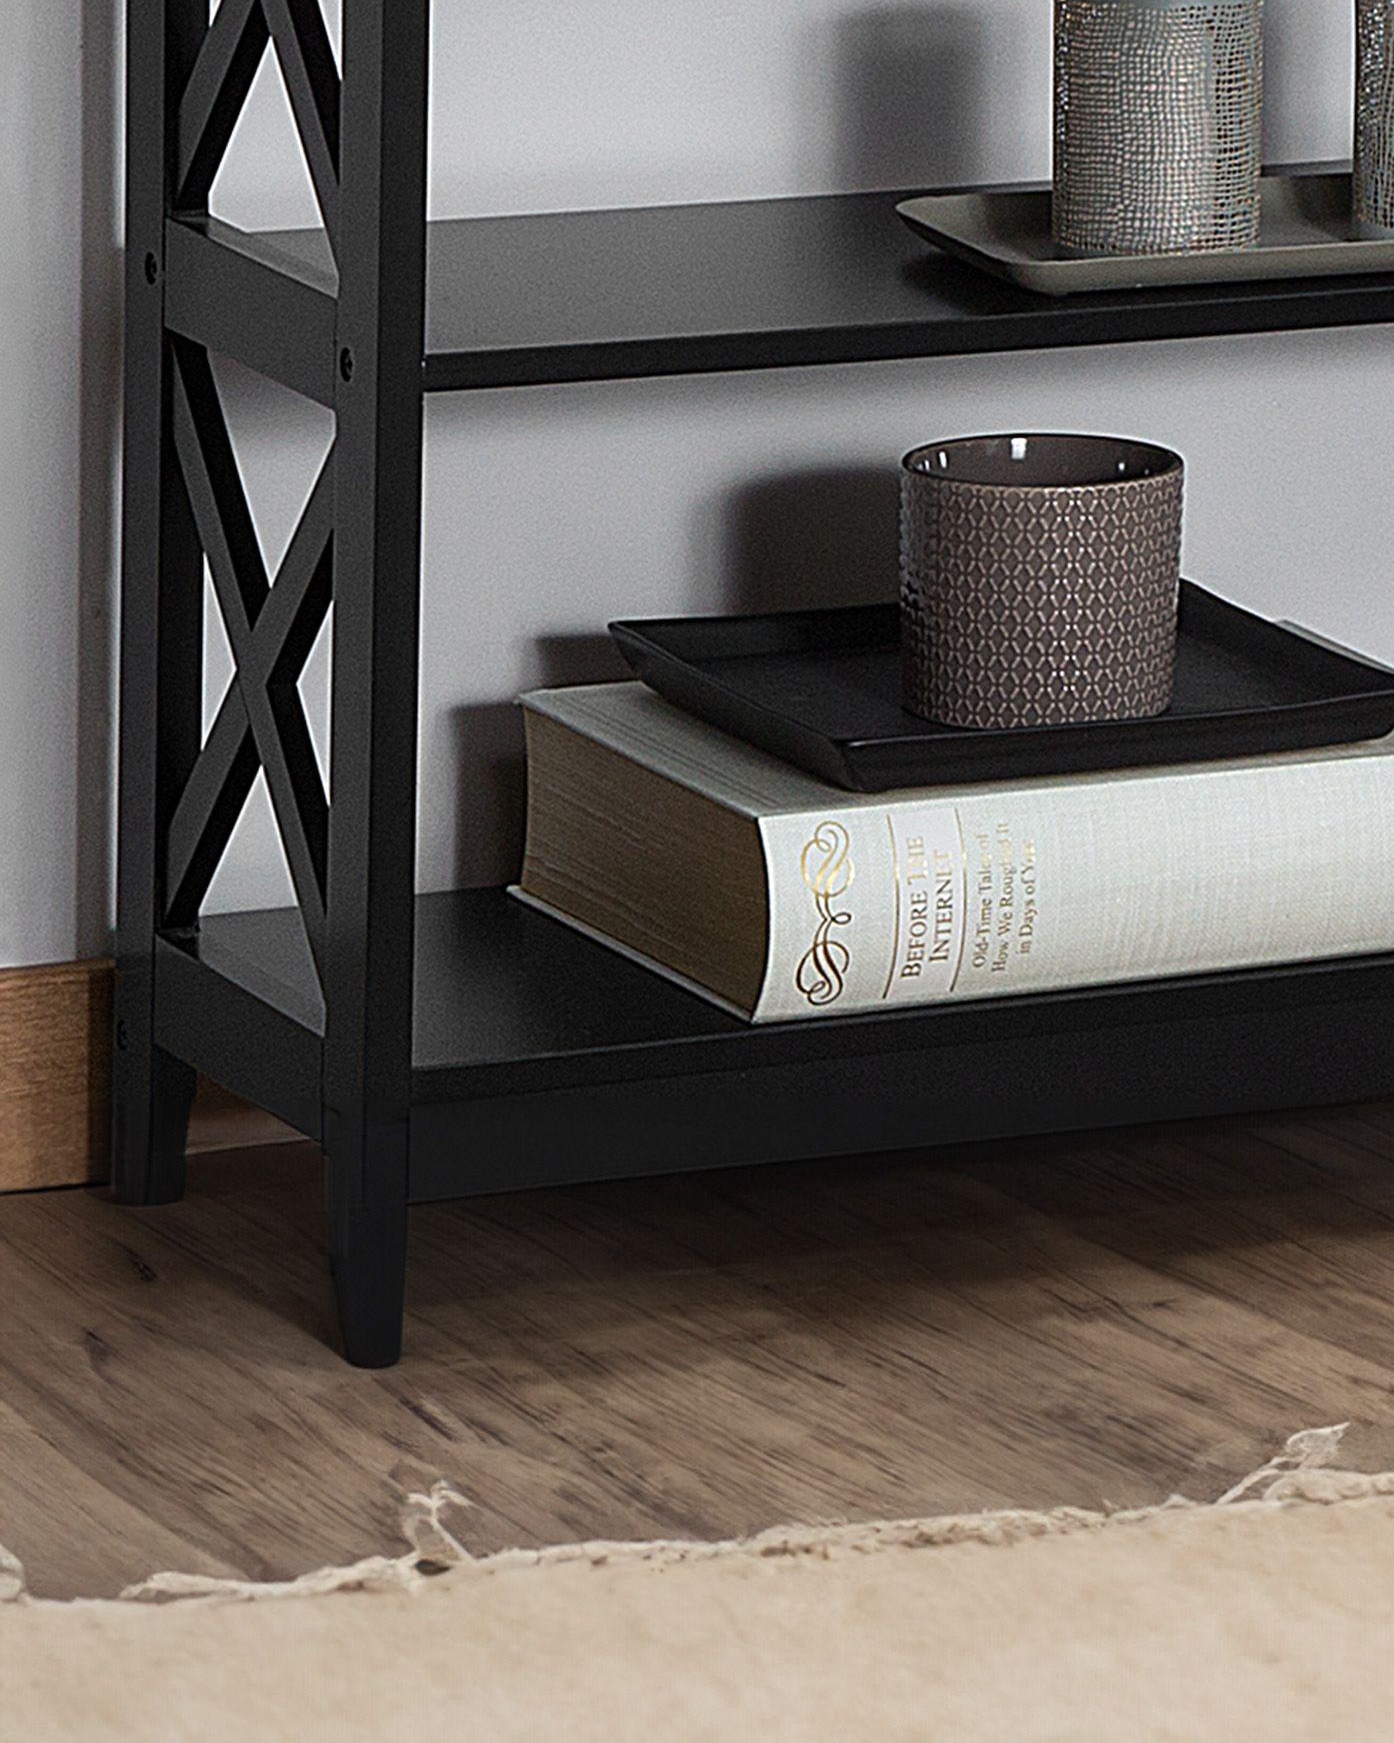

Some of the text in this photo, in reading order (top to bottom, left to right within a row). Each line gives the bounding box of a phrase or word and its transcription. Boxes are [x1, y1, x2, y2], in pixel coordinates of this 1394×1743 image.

[999, 839, 1018, 908] Roughd
[1020, 878, 1036, 895] of
[901, 835, 928, 978] BEFORE THE
[929, 849, 953, 963] INTERNET
[998, 911, 1013, 936] We
[1019, 899, 1038, 938] Days
[972, 897, 992, 968] Old-Time
[1016, 940, 1032, 955] in
[992, 942, 1010, 972] How
